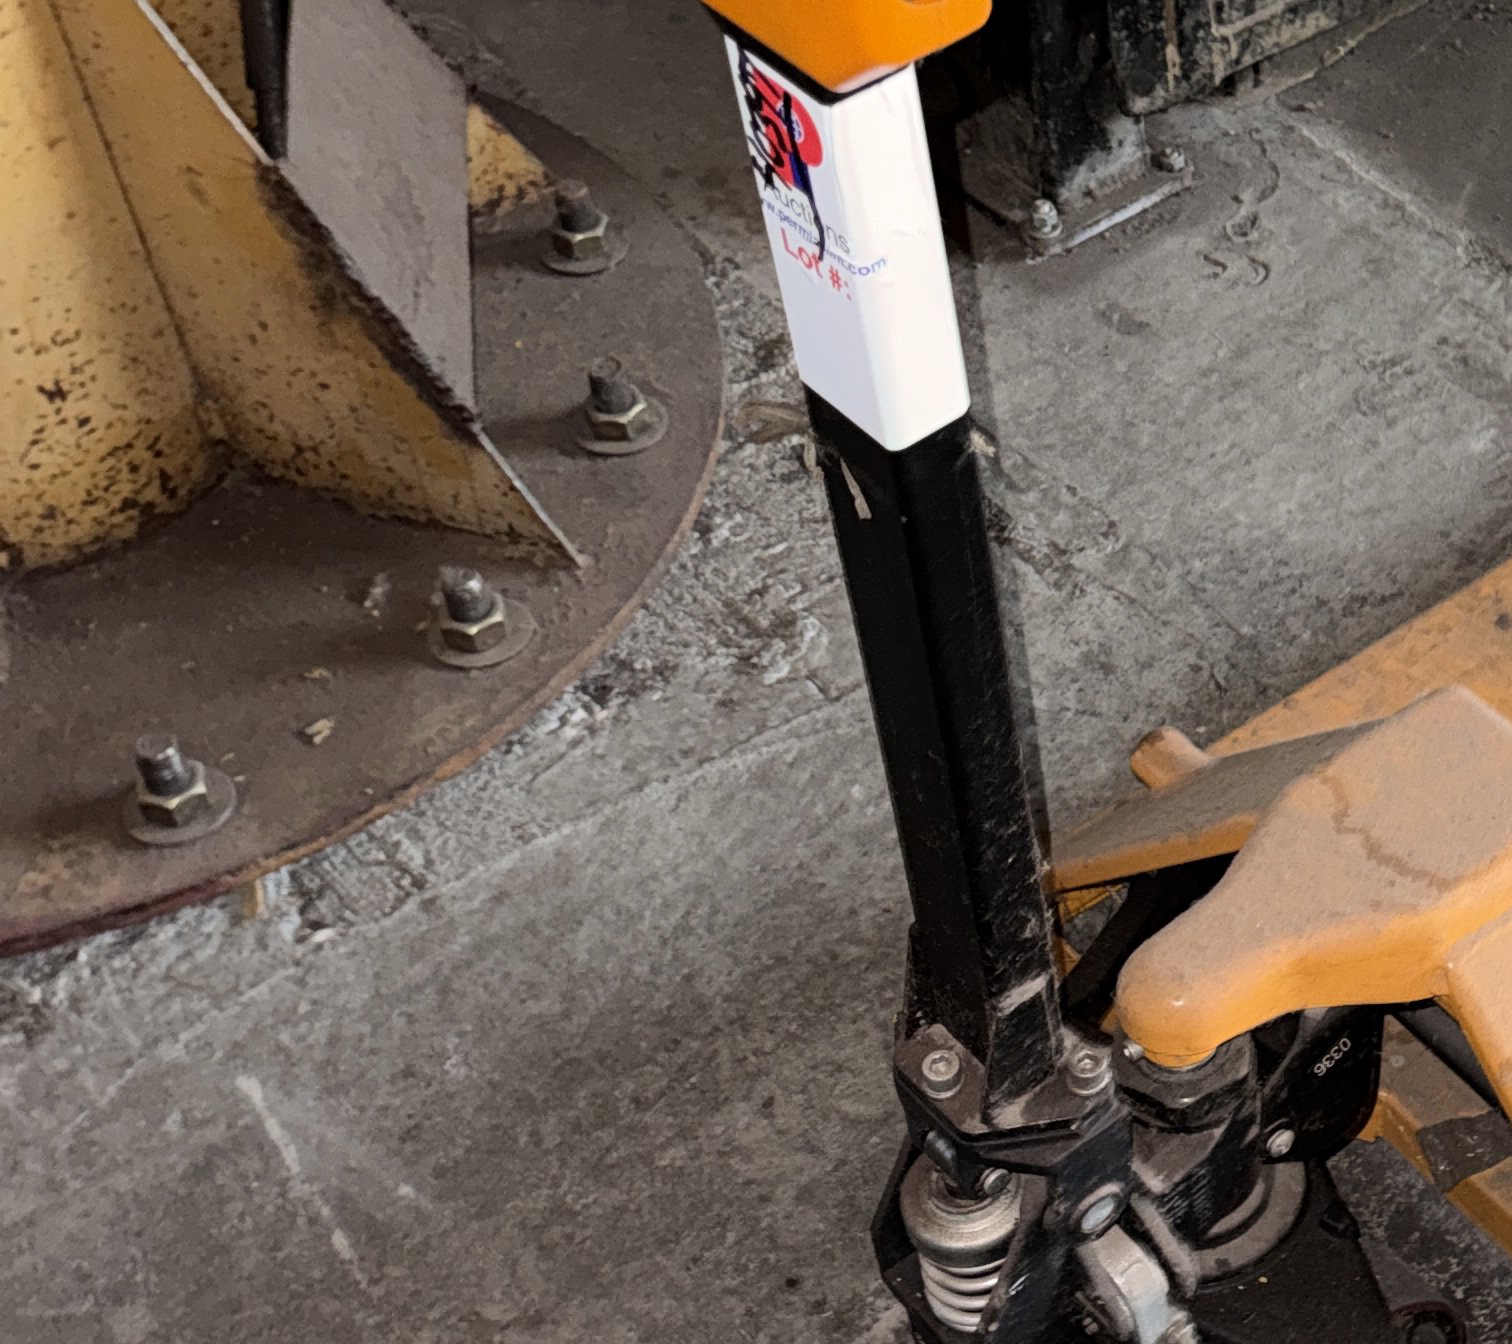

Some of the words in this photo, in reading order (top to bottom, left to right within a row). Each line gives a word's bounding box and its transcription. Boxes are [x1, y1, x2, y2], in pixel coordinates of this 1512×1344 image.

[781, 226, 824, 280] Lot
[828, 265, 853, 301] #:
[1313, 1036, 1352, 1077] 0336
